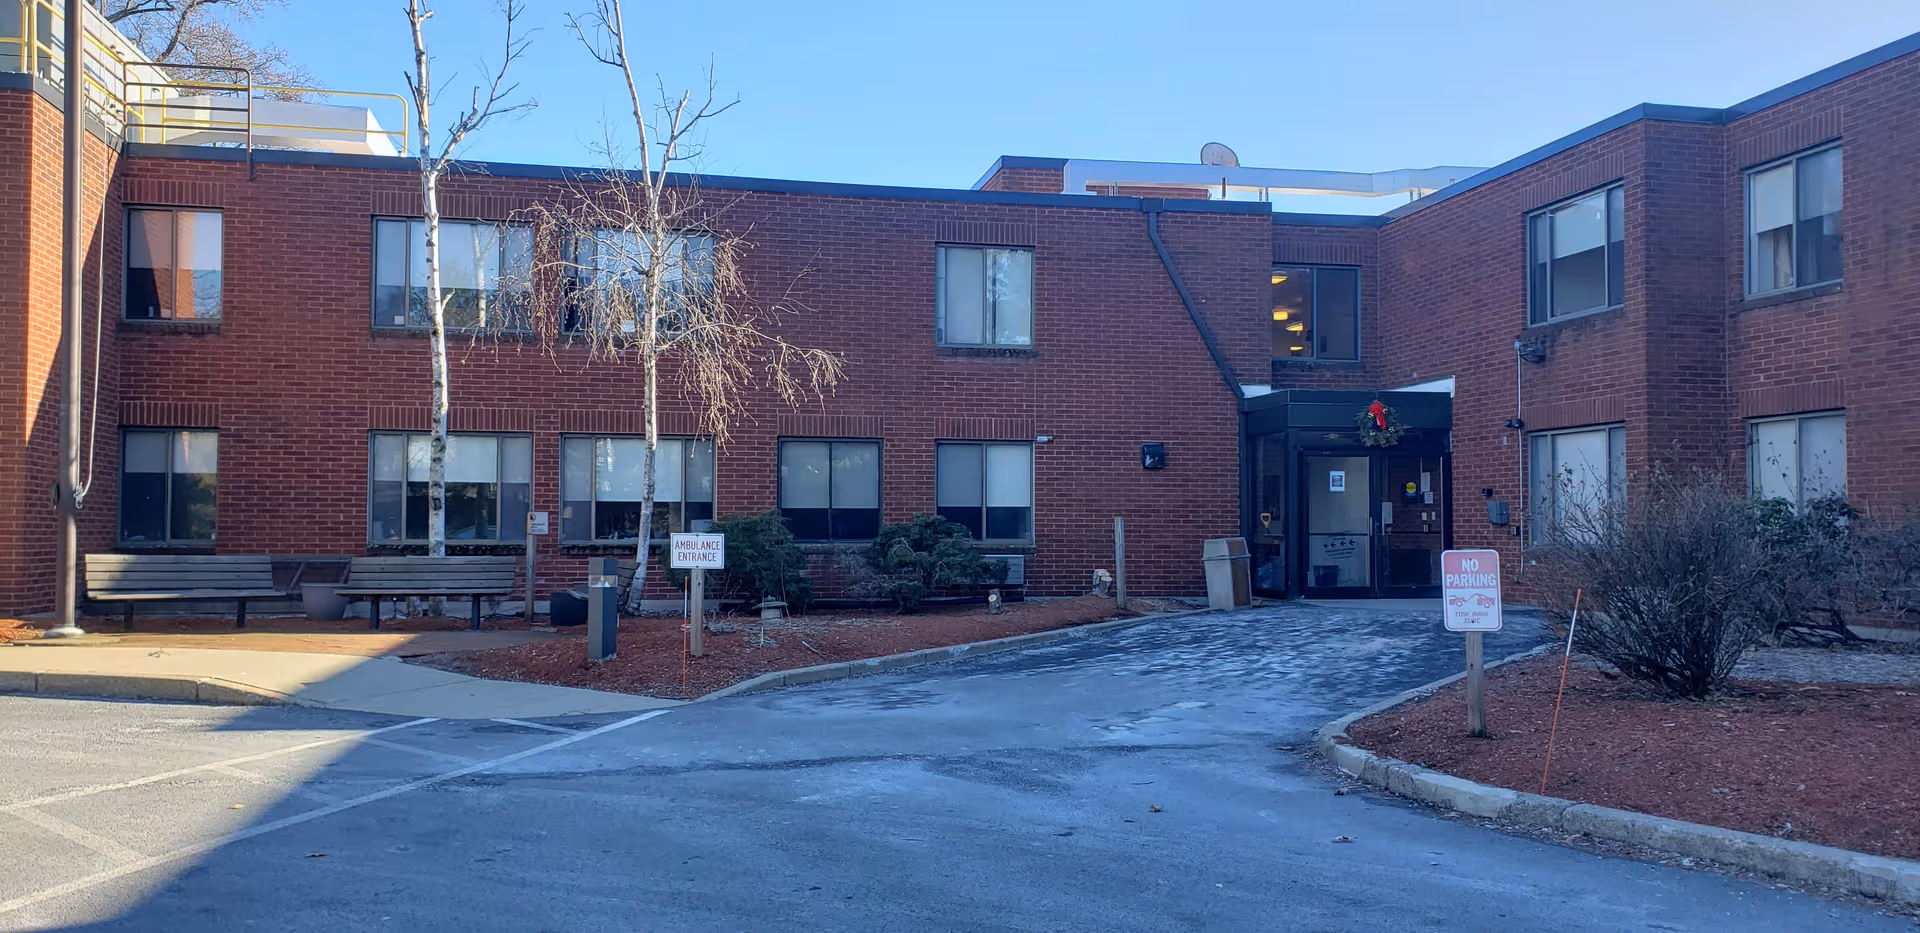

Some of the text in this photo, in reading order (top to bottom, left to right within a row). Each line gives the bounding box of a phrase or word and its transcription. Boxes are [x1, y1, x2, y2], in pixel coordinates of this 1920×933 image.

[675, 540, 721, 550] AMBULANCE
[678, 552, 717, 562] ENTRANCE
[1461, 558, 1479, 572] NO
[1446, 573, 1497, 587] PARKING
